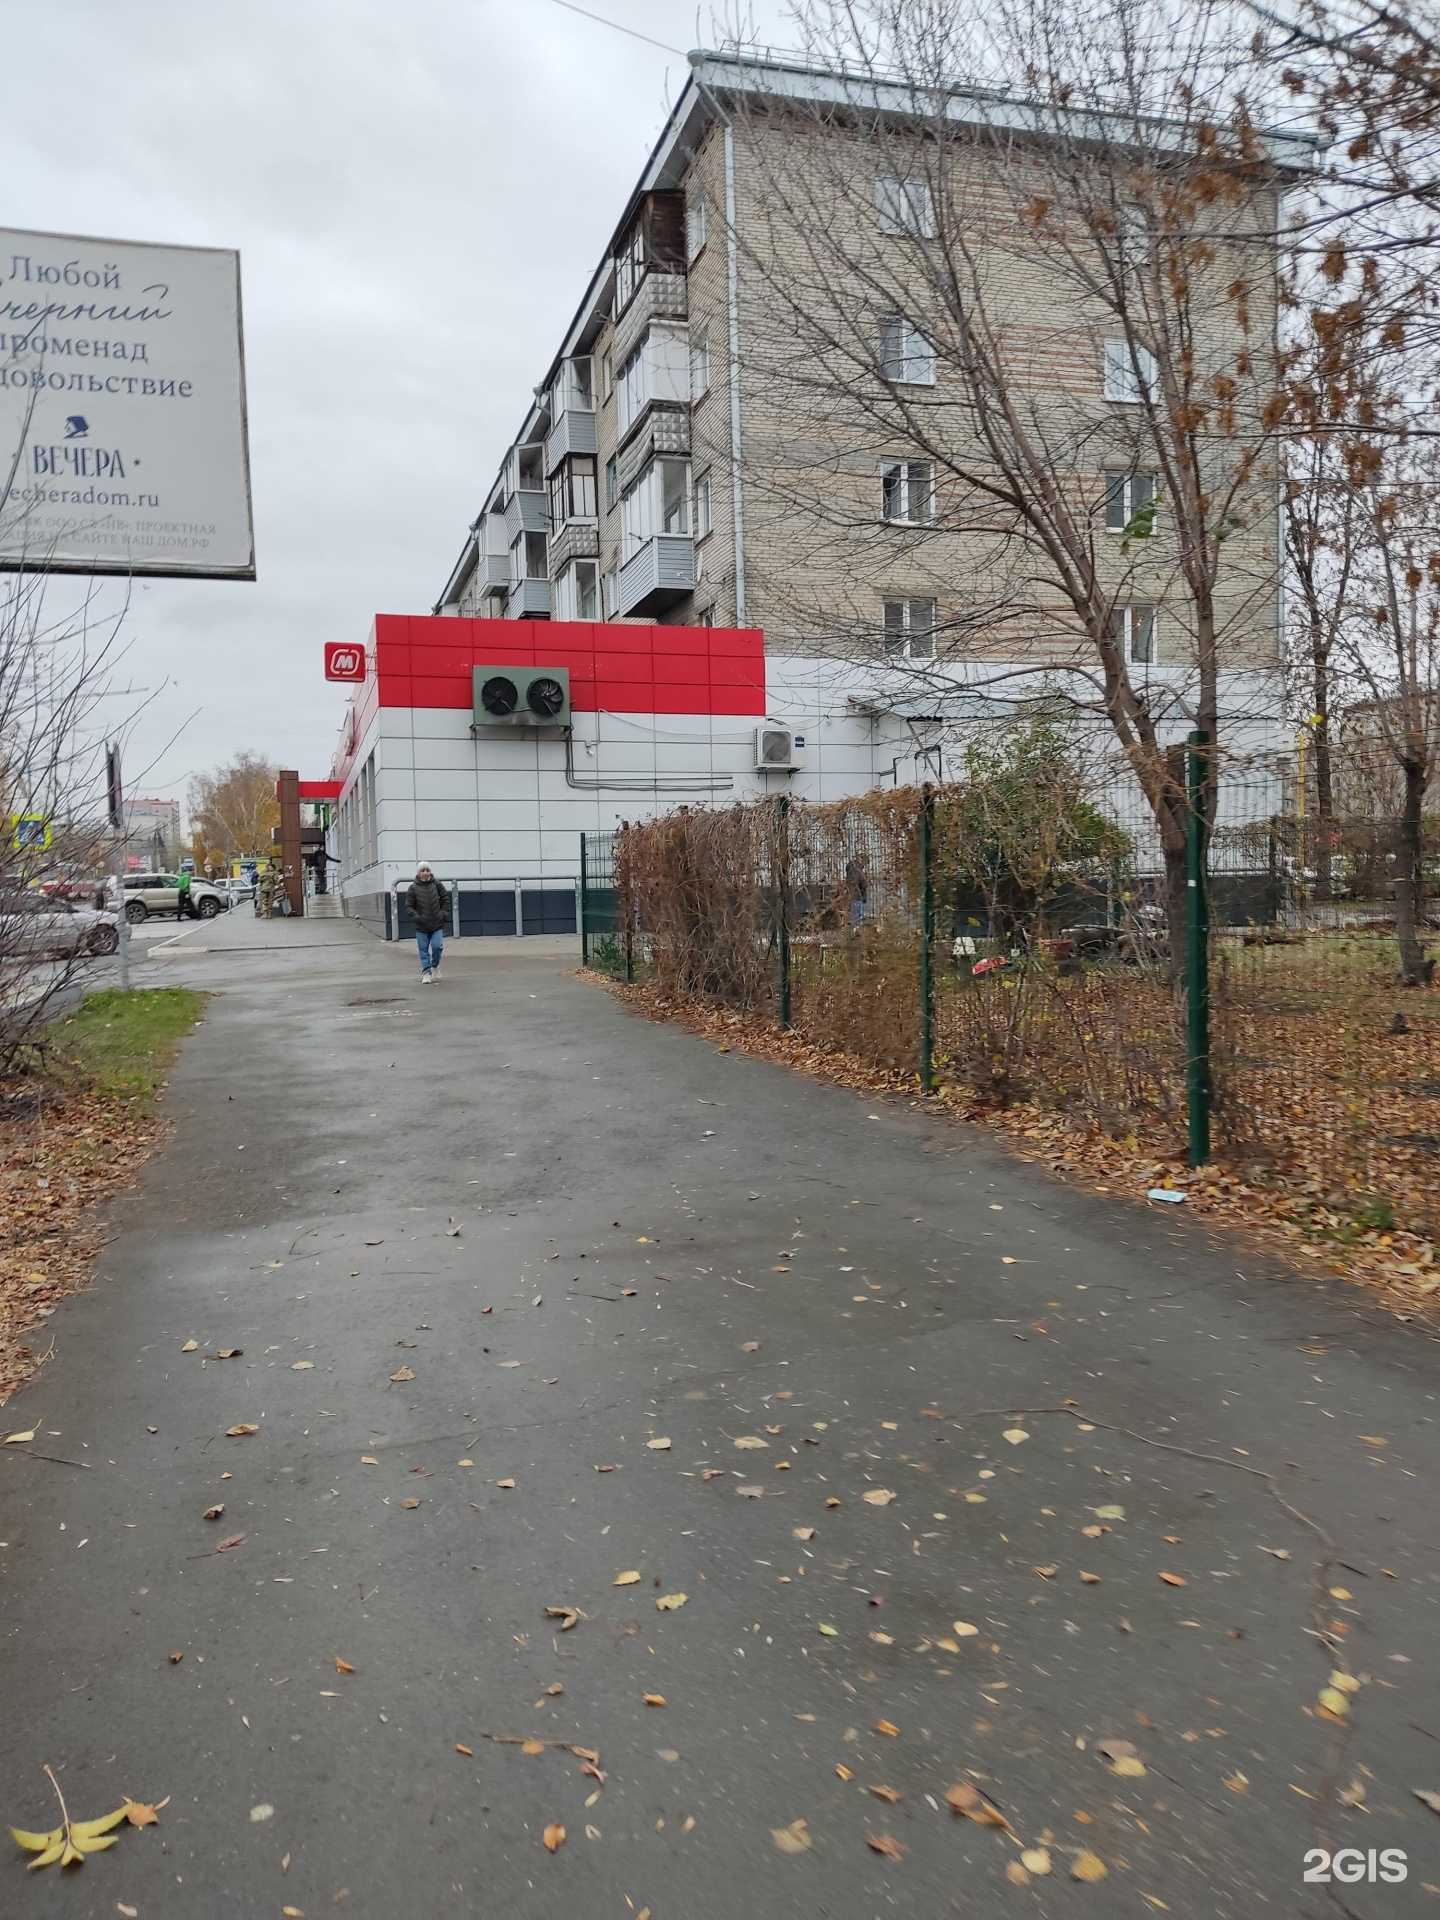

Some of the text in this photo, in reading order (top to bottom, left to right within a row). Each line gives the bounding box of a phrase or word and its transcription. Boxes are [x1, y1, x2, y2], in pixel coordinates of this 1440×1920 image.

[9, 255, 121, 290] Любой
[33, 444, 126, 479] ВЕЧЕРА
[136, 519, 216, 535] ПРОЕКТНАЯ
